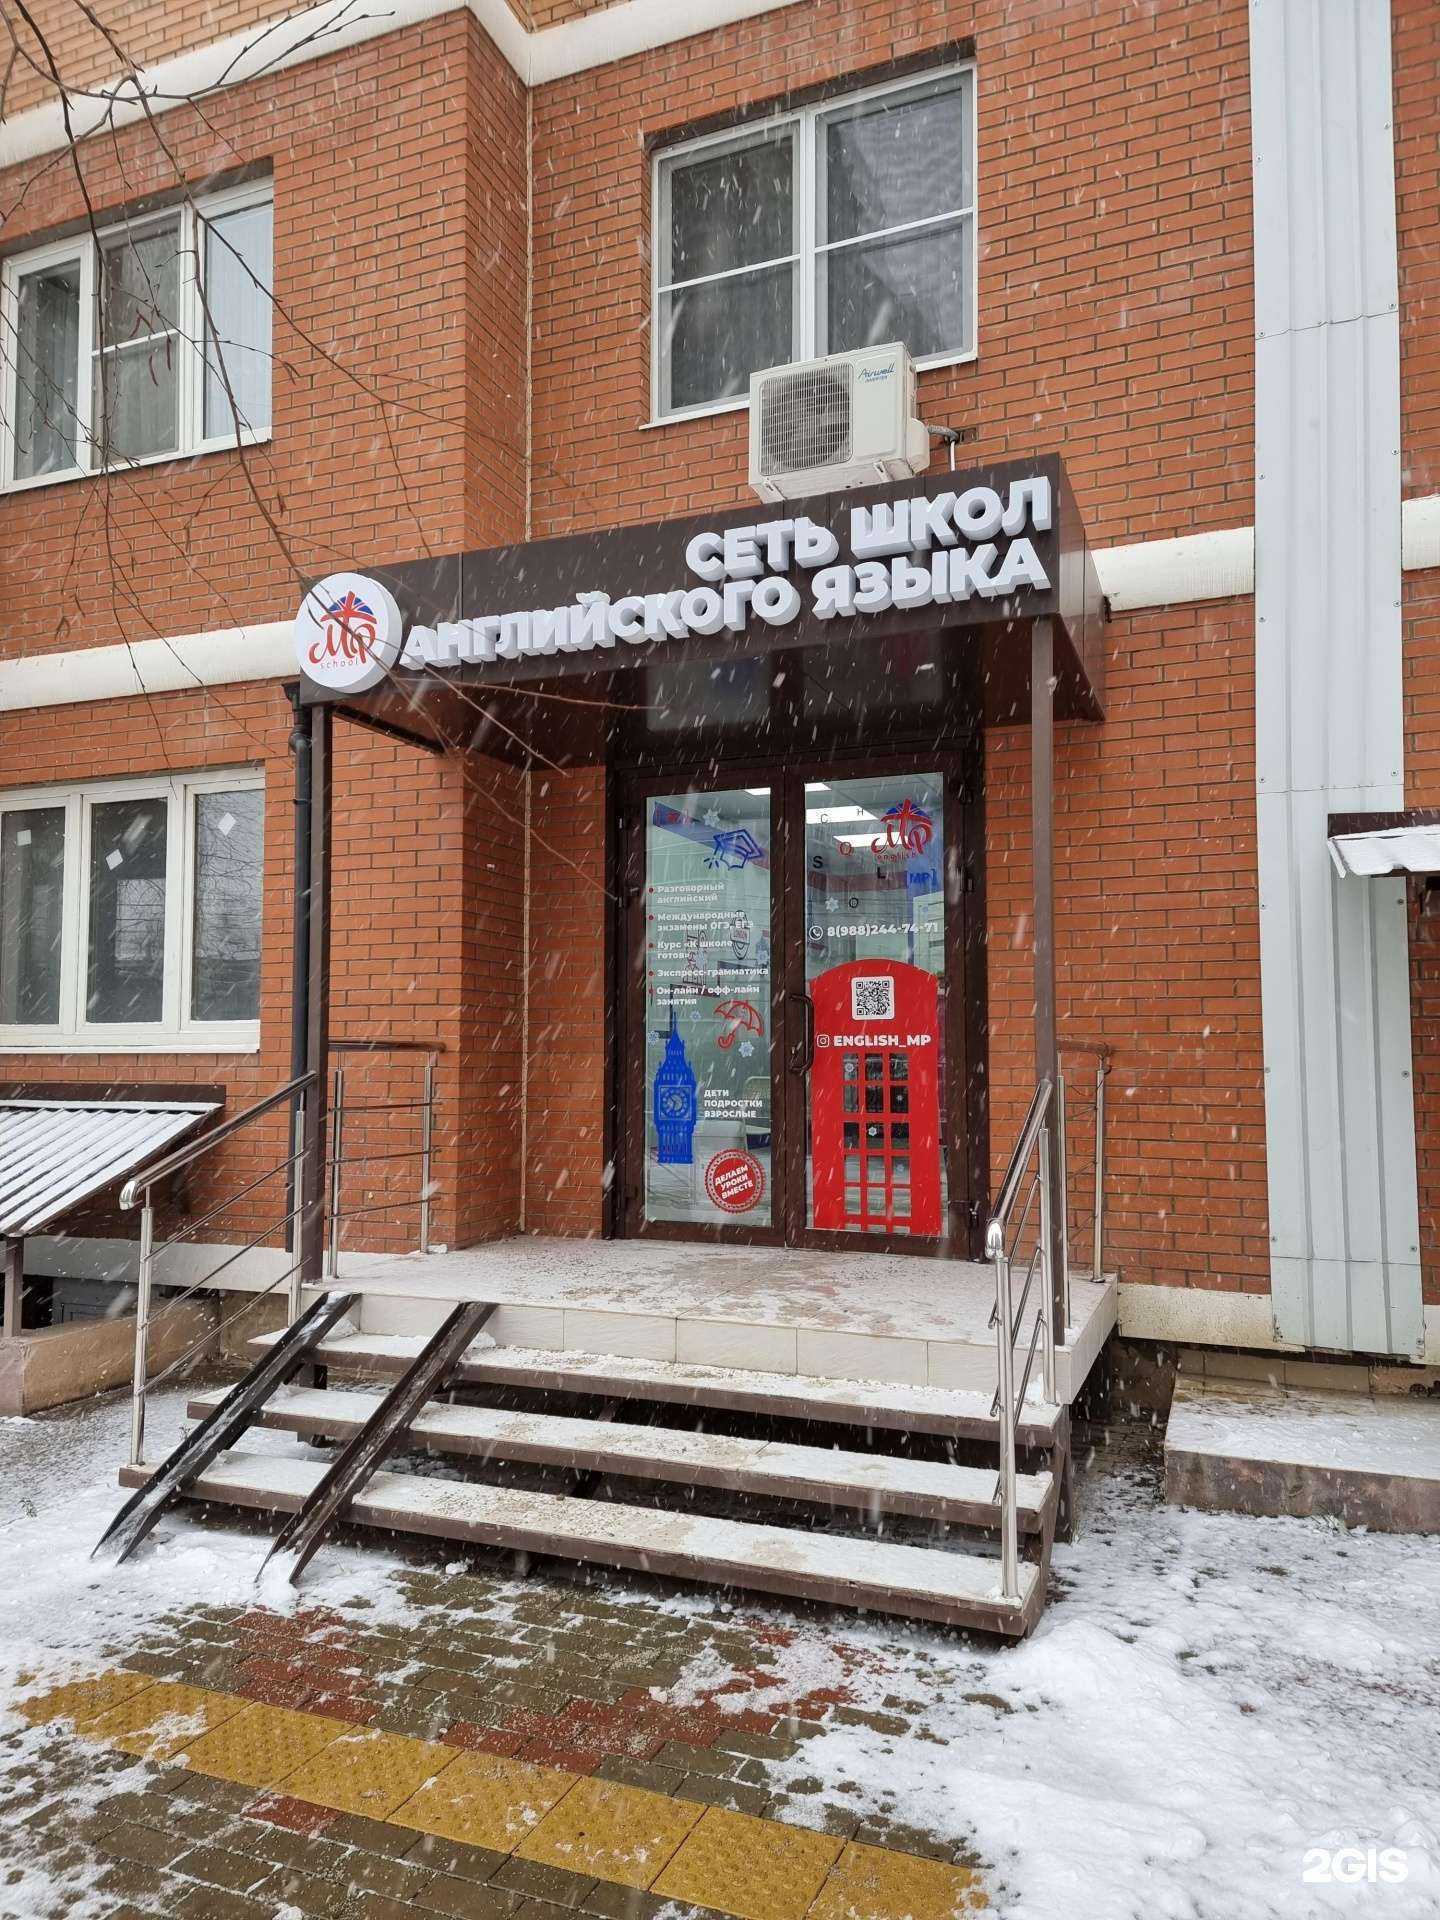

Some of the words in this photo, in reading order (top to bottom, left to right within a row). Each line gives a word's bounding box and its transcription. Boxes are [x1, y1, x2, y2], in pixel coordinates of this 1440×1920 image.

[685, 517, 839, 582] СЕТЬ
[850, 475, 1052, 558] ШКОЛ
[400, 576, 800, 670] АНГЛИЙСКОГО
[812, 537, 1052, 620] ЯЗЫКА
[320, 659, 359, 669] school
[657, 883, 725, 893] Разговорный
[657, 893, 719, 904] английский
[657, 911, 745, 922] Международные
[657, 922, 708, 932] экзамены
[827, 922, 939, 938] 8(988)244-74-71
[657, 941, 682, 951] Курс
[699, 940, 733, 948] школе
[657, 968, 769, 977] Экспресс-грамматика
[657, 984, 699, 995] Он-лайн
[708, 984, 760, 996] офф-лайн
[657, 998, 697, 1006] занятия
[833, 1034, 931, 1048] ENGLISH_MP
[704, 1089, 730, 1098] ДЕТИ
[704, 1099, 763, 1109] ПОДРОСТКИ
[704, 1110, 757, 1119] ВЗРОСЛЫЕ
[715, 1164, 749, 1186] ДЕЛАЕМ
[721, 1173, 748, 1191] УРОКИ
[721, 1180, 754, 1200] ВМЕСТЕ
